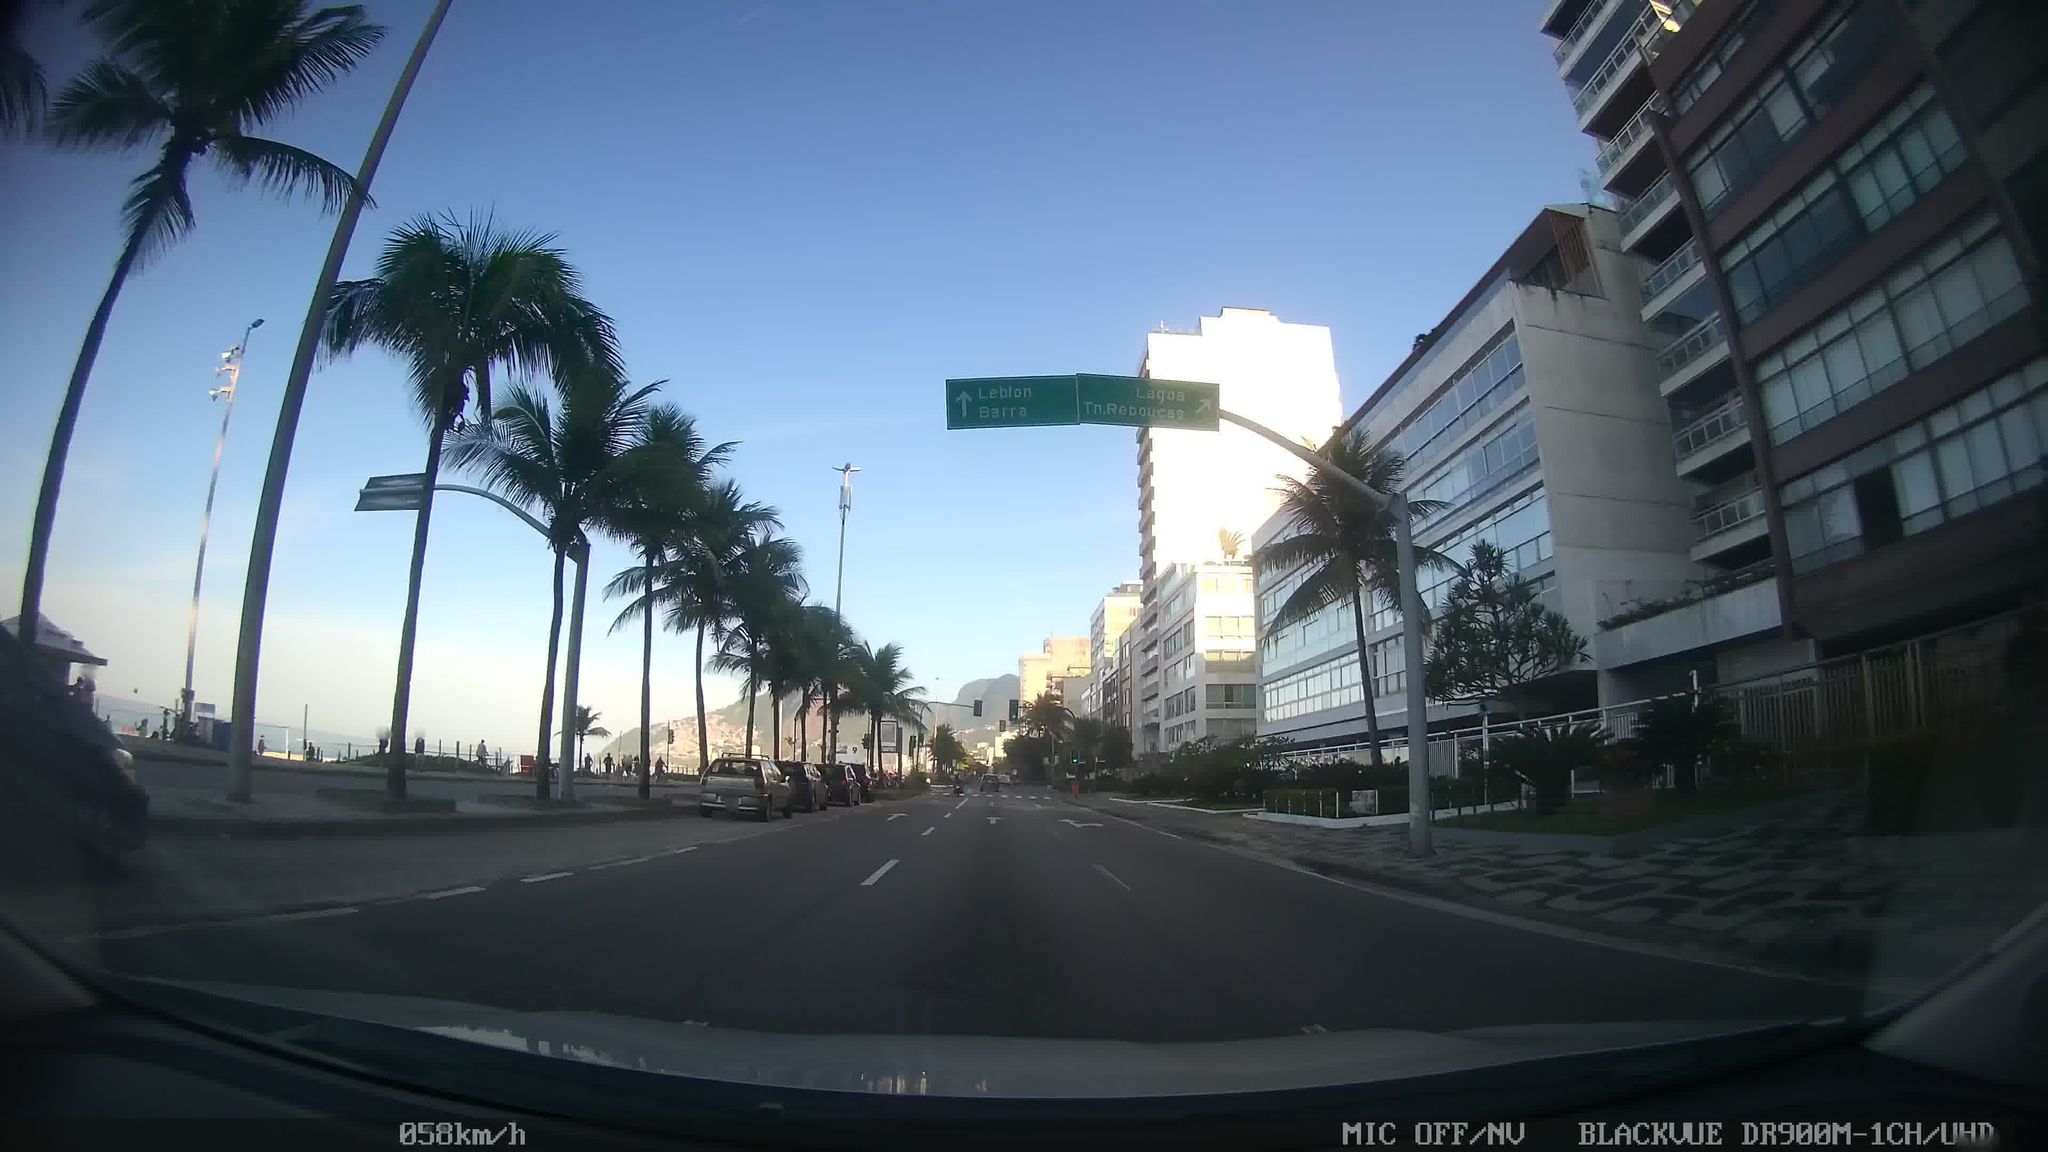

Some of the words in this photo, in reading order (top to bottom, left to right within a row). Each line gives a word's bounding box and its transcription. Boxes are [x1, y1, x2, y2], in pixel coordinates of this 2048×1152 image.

[979, 385, 1032, 399] Leblon
[1137, 388, 1185, 402] Lagoa
[980, 406, 1027, 419] Barra
